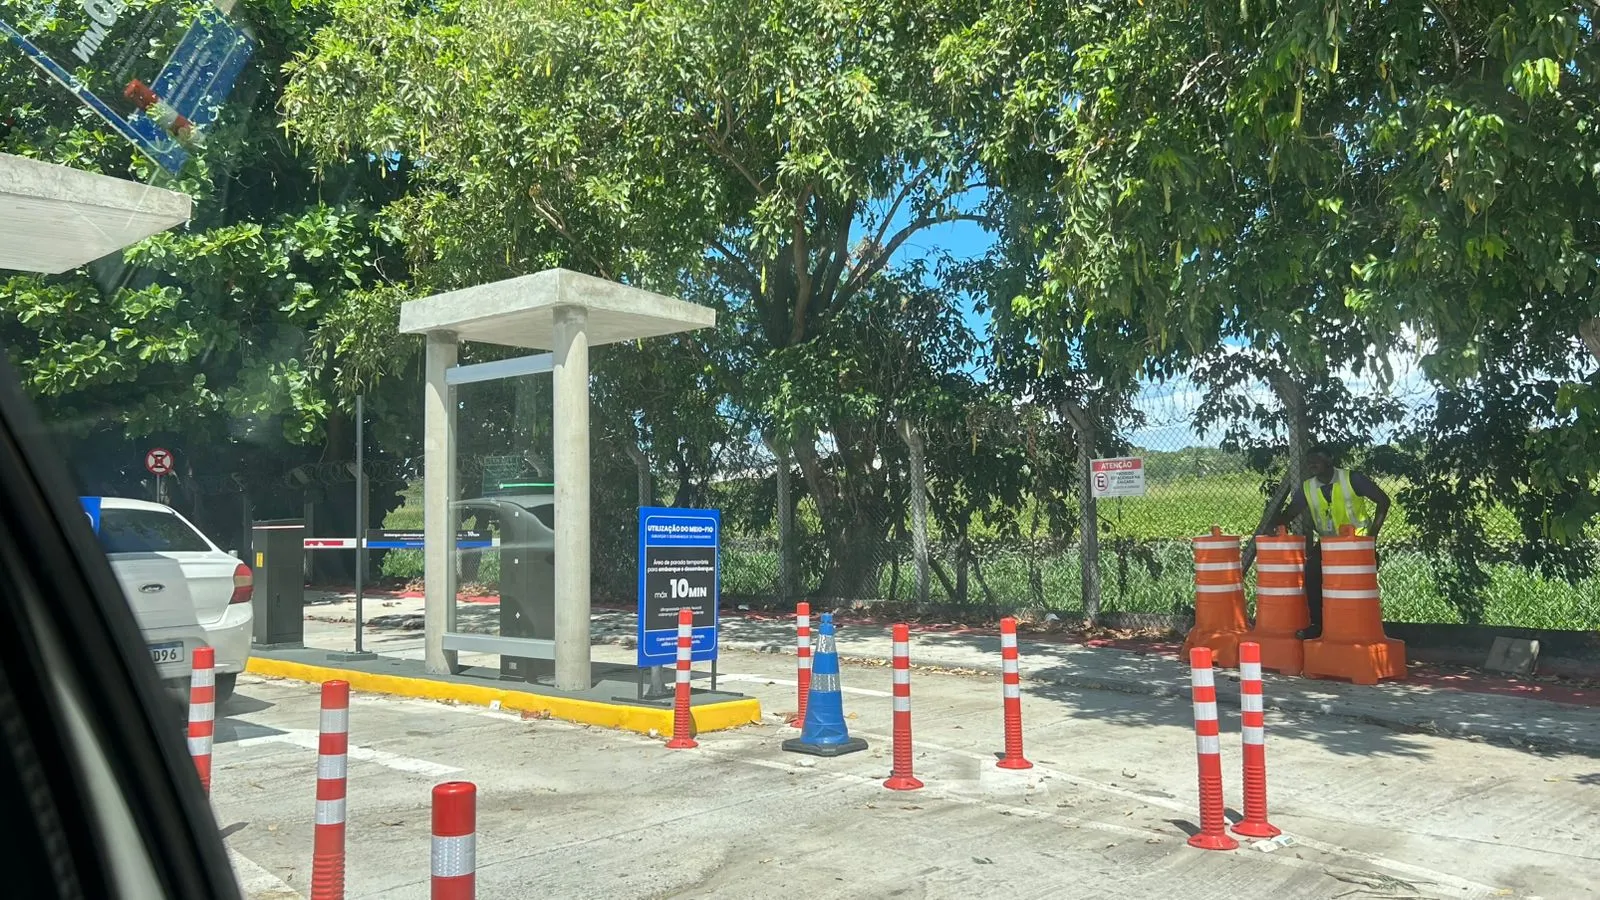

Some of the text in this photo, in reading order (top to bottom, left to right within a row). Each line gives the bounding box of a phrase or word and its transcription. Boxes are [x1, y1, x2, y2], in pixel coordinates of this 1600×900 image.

[1101, 461, 1132, 470] ATENÇÃO
[648, 524, 680, 534] UTILIZAÇÃO
[654, 591, 668, 599] máx
